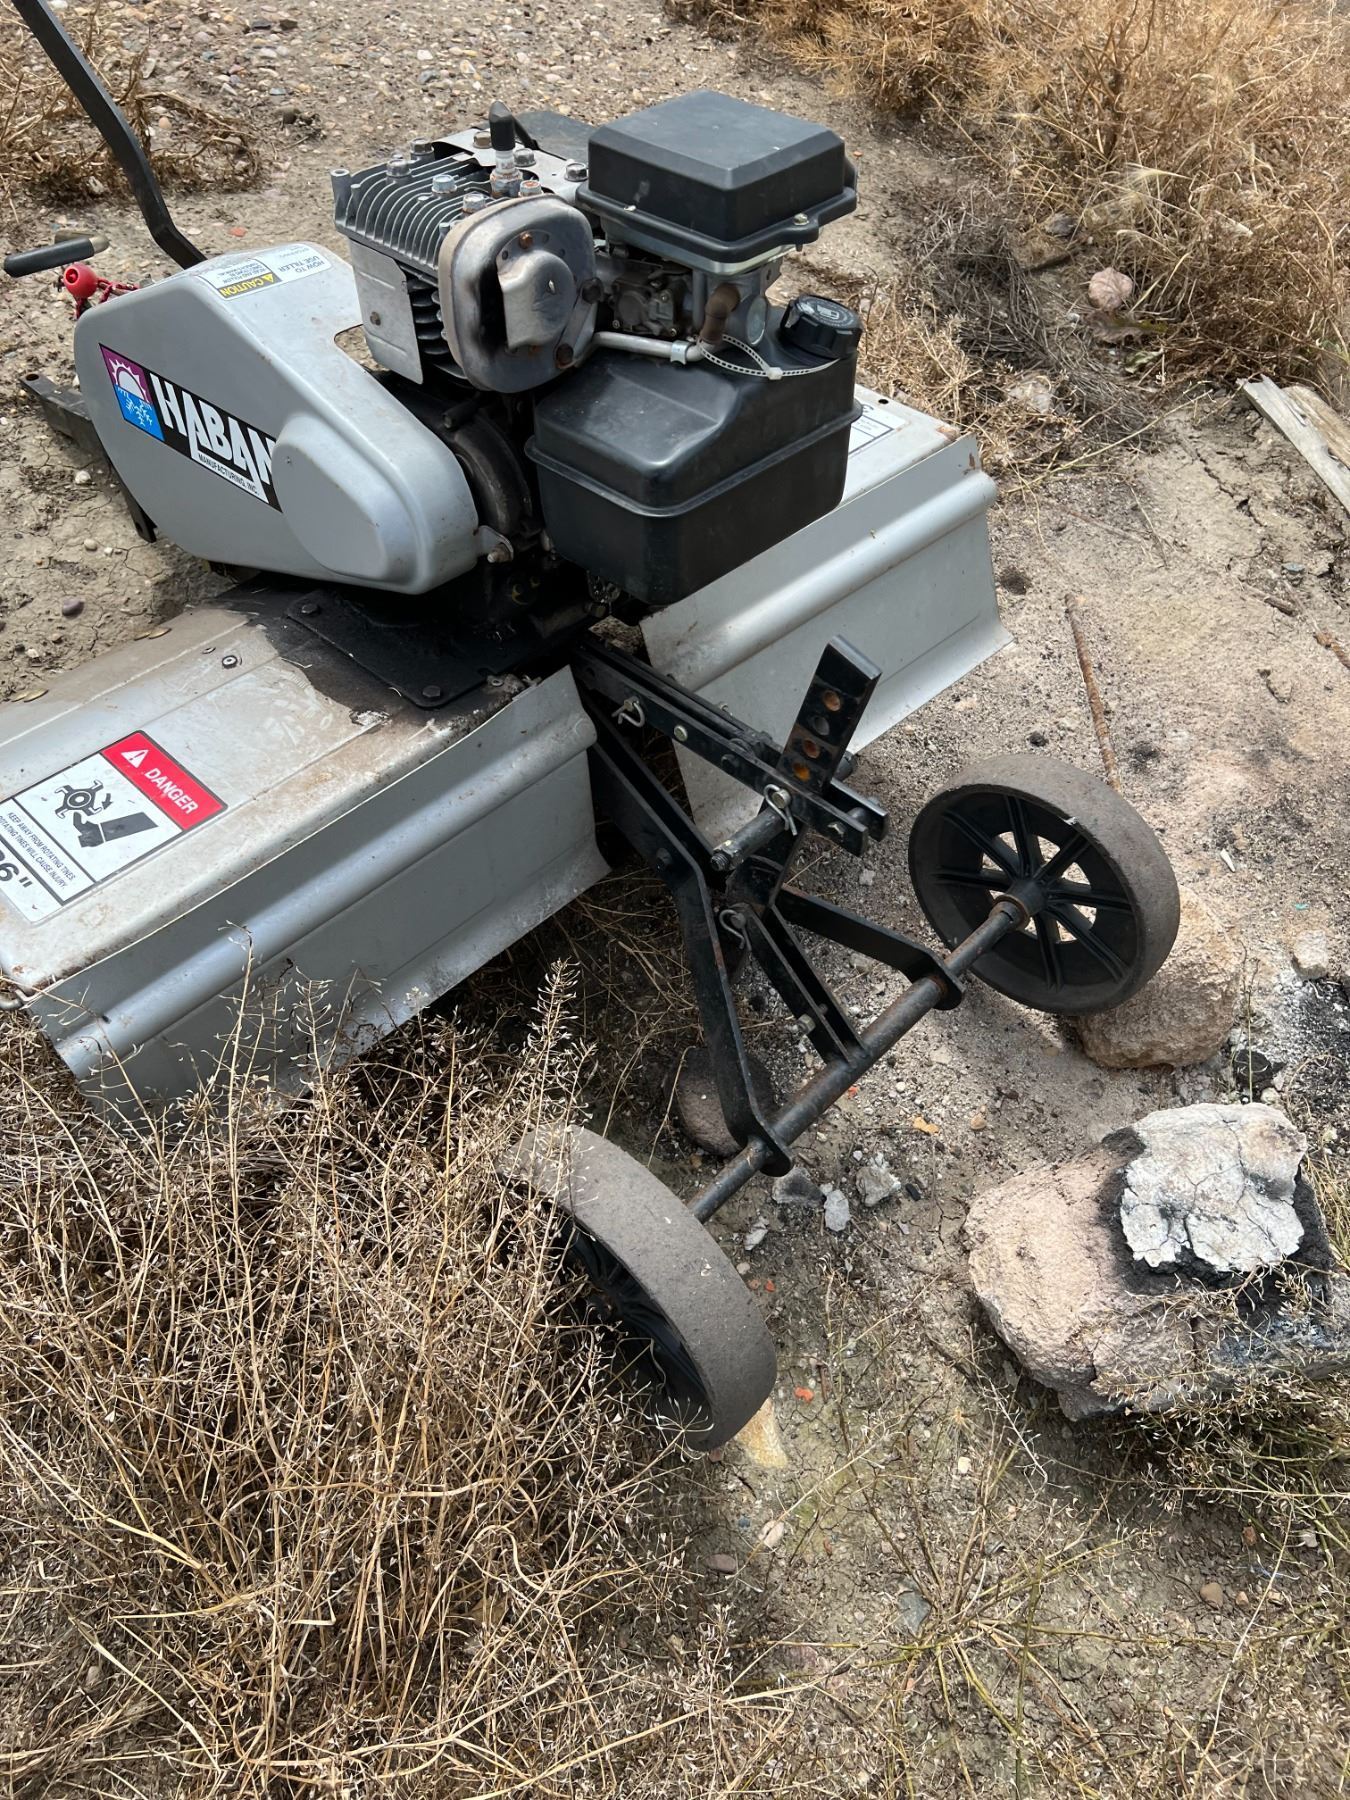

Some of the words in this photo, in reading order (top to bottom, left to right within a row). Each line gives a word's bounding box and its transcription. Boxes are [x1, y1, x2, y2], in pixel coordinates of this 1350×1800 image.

[278, 260, 304, 272] TILLER
[307, 260, 325, 270] HOW
[219, 277, 264, 296] CAUTION
[150, 372, 276, 492] HABAN
[144, 767, 199, 815] DANGER
[8, 812, 21, 823] KEEP
[17, 822, 33, 835] AWAY
[30, 833, 45, 848] FROM
[40, 845, 64, 869] ROTATING
[15, 834, 30, 848] TINES
[26, 846, 39, 859] WILL
[35, 856, 53, 873] CAUSE
